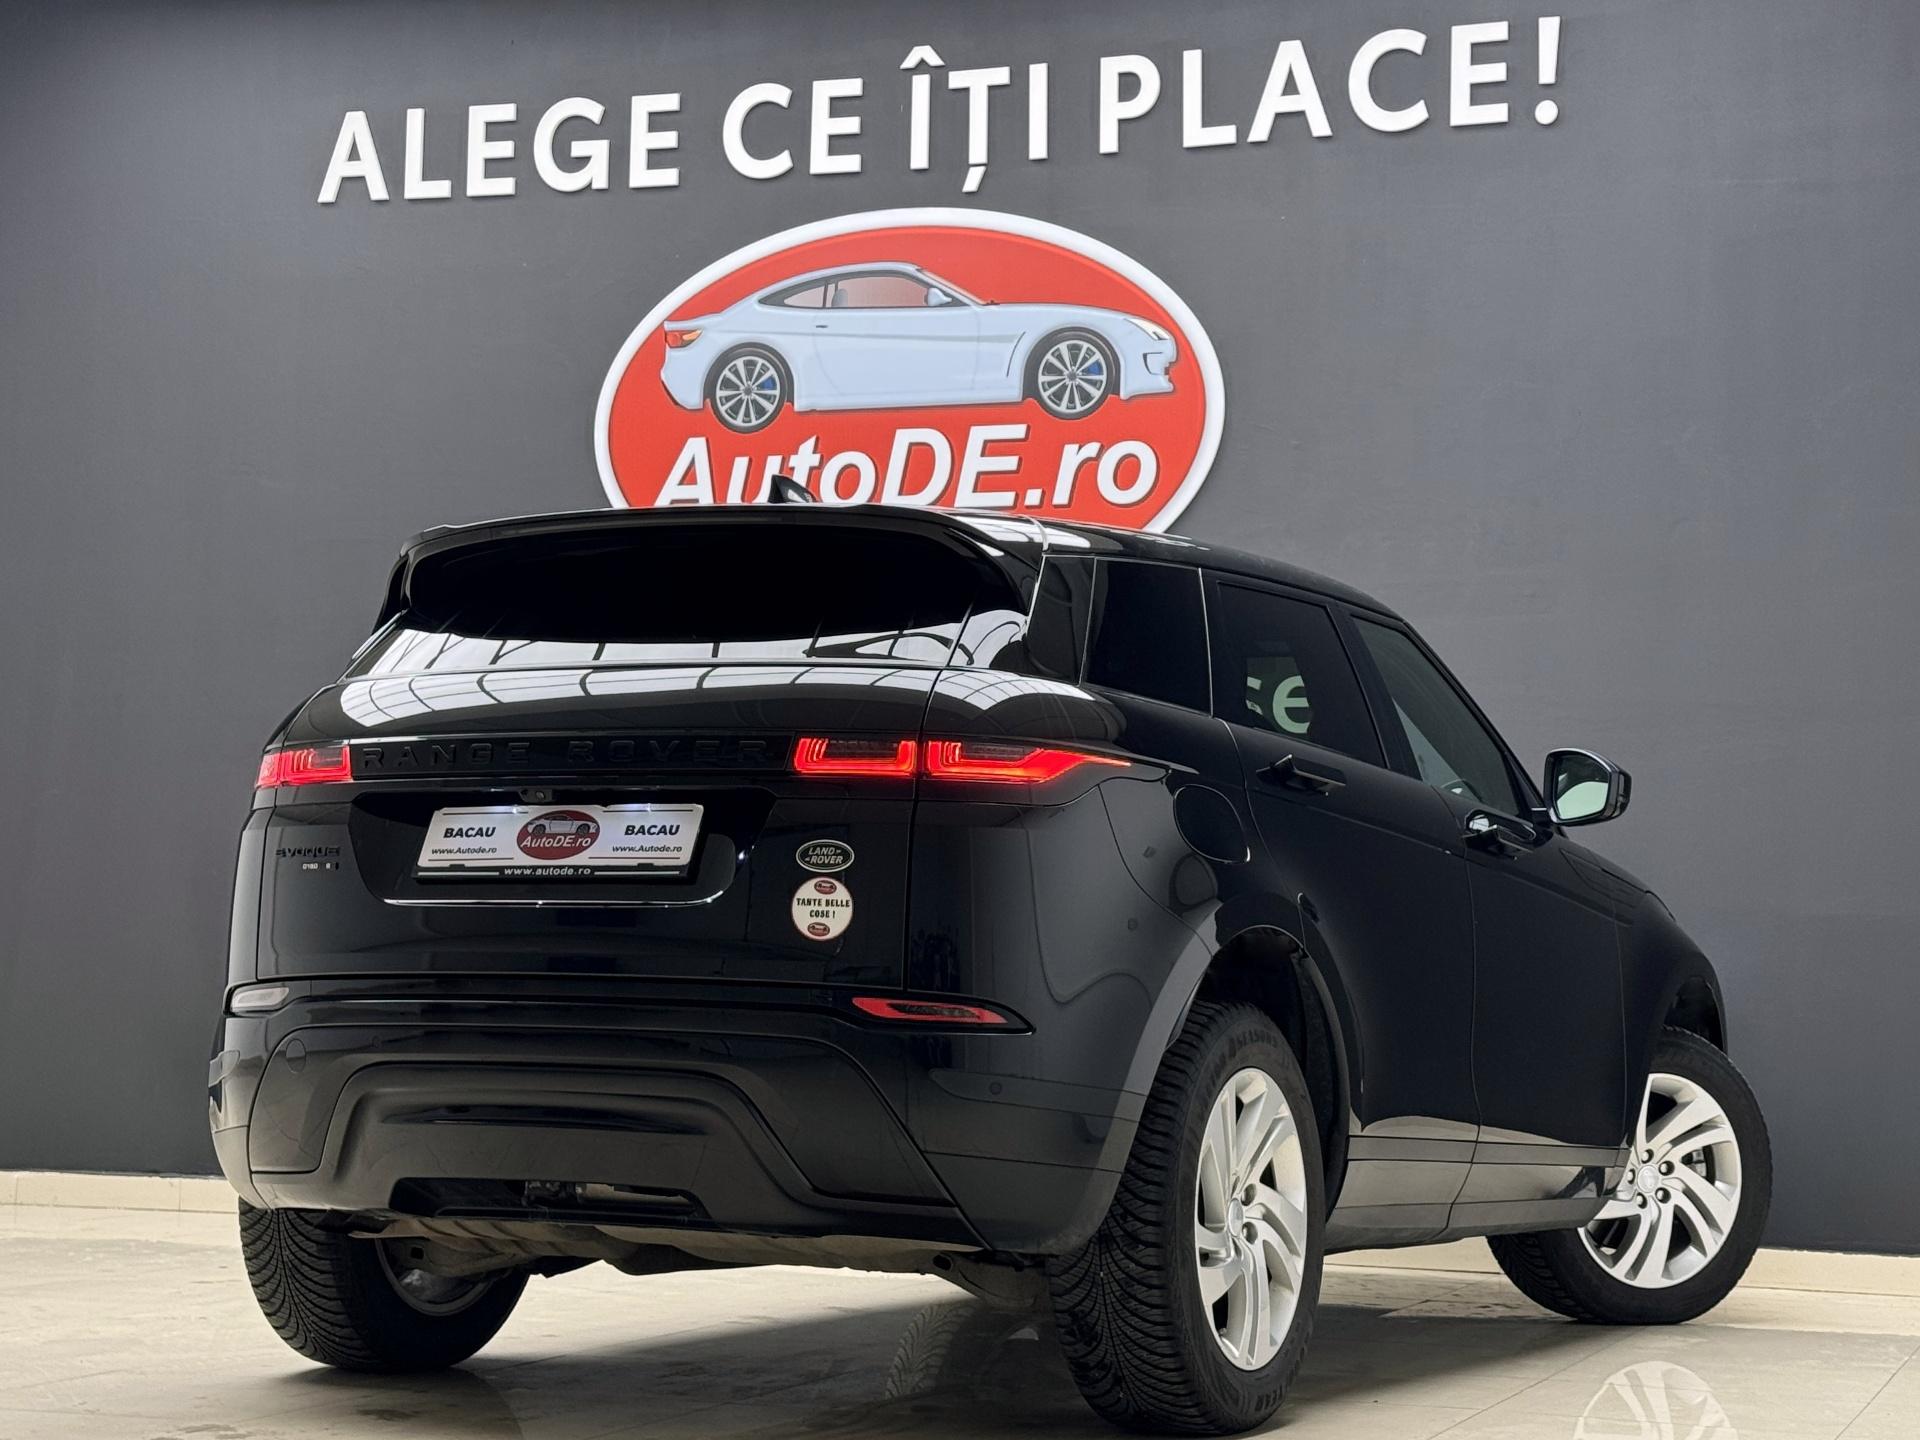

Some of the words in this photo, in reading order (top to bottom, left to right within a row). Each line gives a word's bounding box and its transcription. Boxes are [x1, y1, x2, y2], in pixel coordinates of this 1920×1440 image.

[317, 92, 682, 204] ALEGE
[721, 77, 864, 180] CE
[1099, 15, 1562, 154] PLACE!
[654, 423, 1158, 508] AutoDE.ro
[362, 741, 531, 770] RANGE
[567, 739, 769, 765] ROVER
[443, 826, 496, 838] BACAU
[624, 824, 681, 836] BACAU
[520, 835, 593, 849] AutoDE.ro
[431, 846, 497, 855] www.Autode.ro
[612, 844, 683, 853] www.Autode.ro
[808, 846, 836, 855] LAND
[809, 855, 844, 864] ROVER
[504, 866, 591, 876] www.autode.ro
[796, 897, 822, 906] TANTE
[825, 898, 851, 908] BELLE
